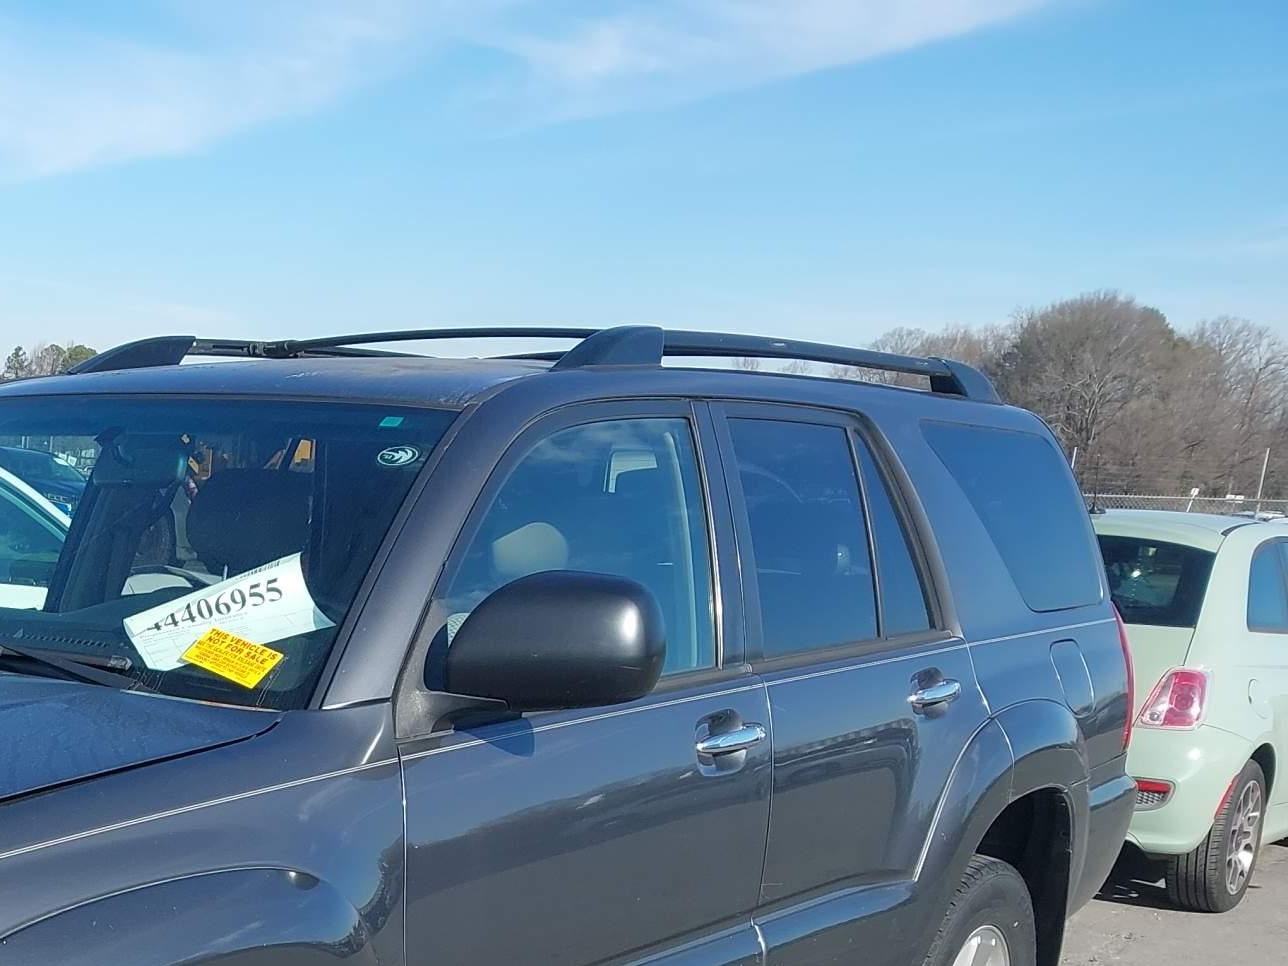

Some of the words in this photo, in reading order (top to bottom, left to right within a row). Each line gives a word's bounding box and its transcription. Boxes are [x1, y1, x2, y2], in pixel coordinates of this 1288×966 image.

[206, 636, 226, 646] NOT
[226, 643, 244, 654] FOR
[245, 651, 268, 665] SALE
[210, 628, 229, 640] THIS
[230, 636, 266, 656] VEHICLE
[267, 651, 278, 660] IS
